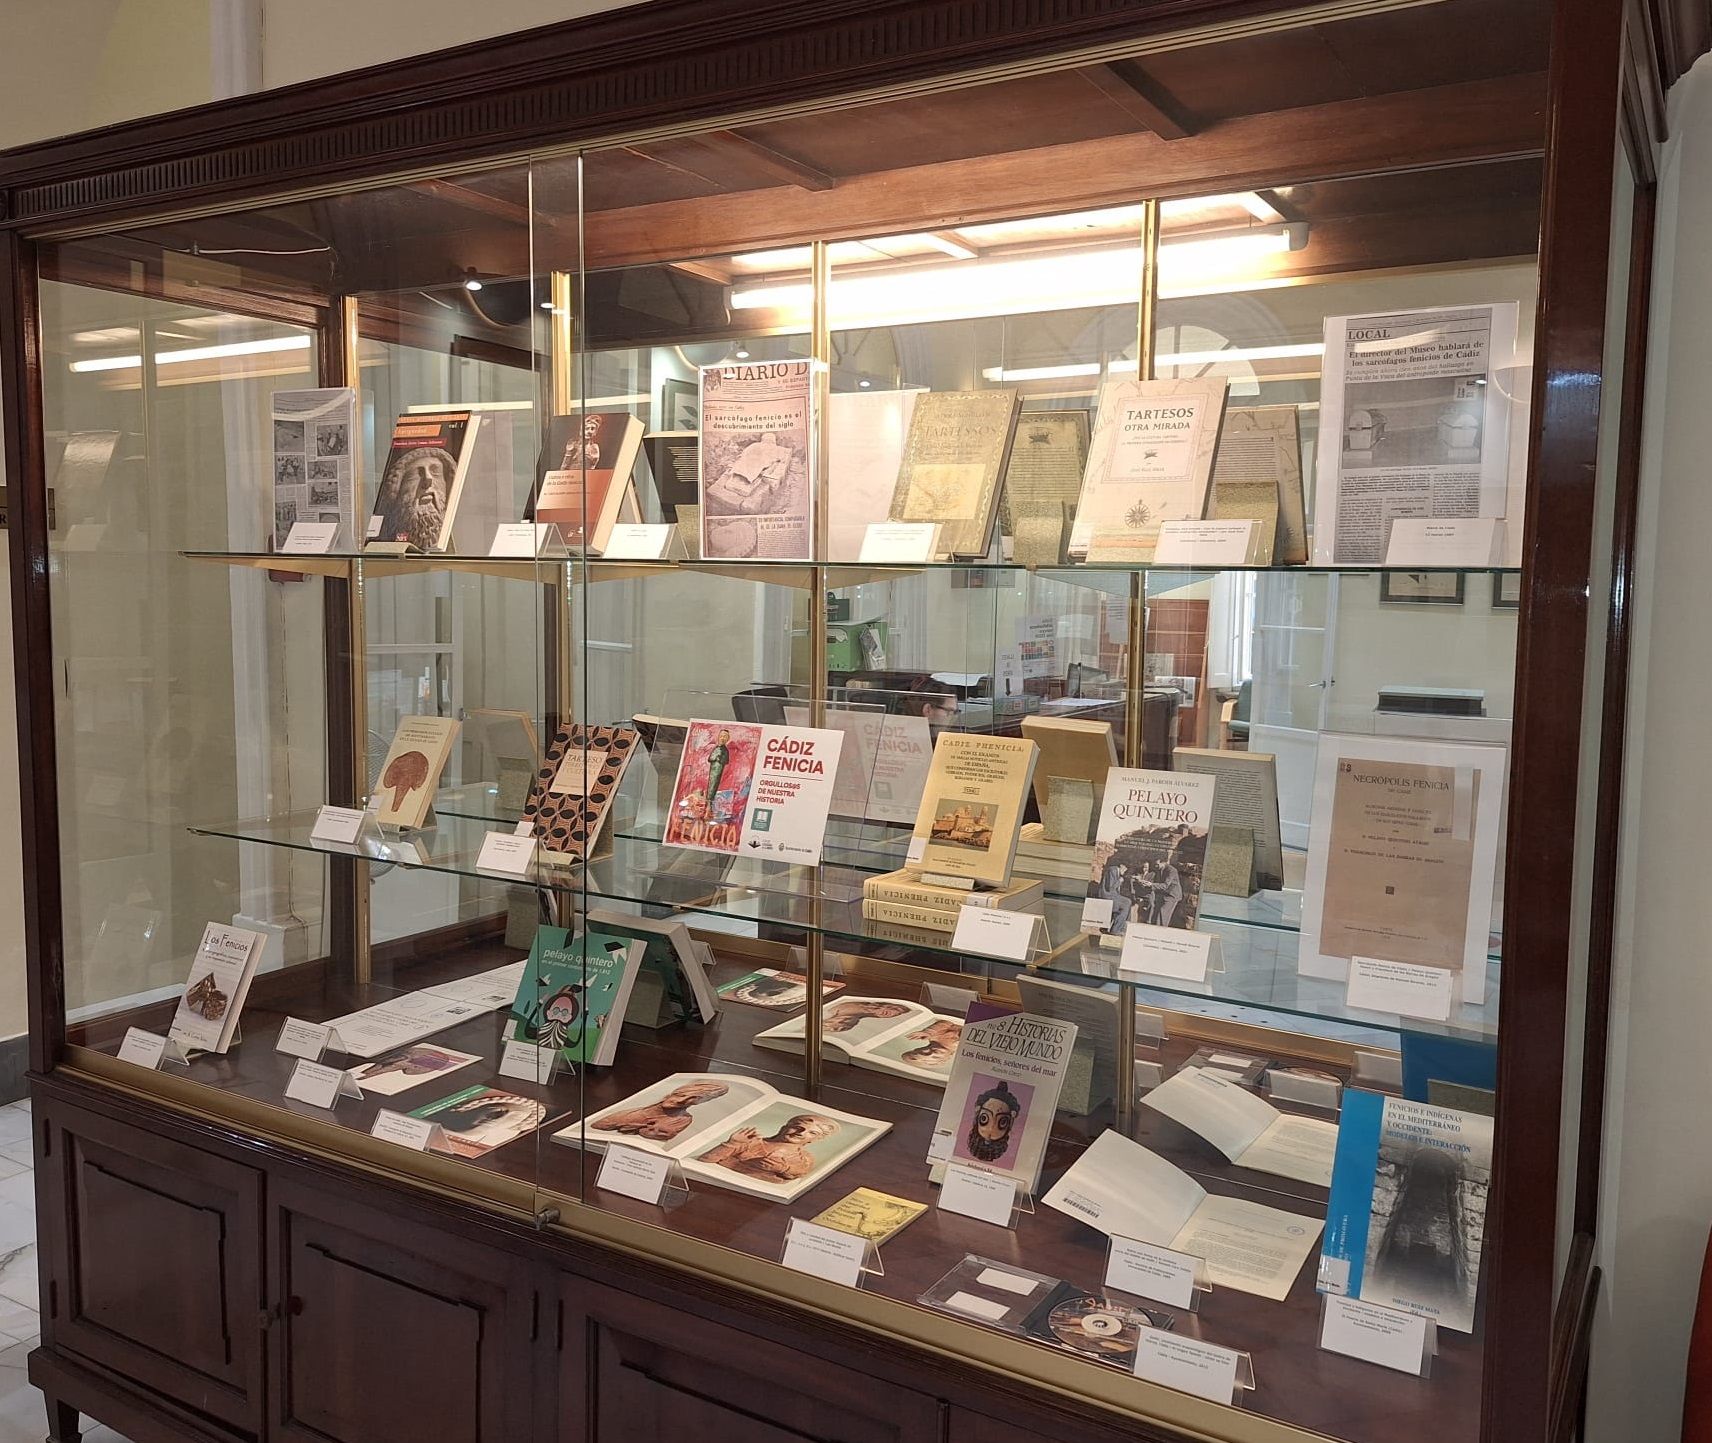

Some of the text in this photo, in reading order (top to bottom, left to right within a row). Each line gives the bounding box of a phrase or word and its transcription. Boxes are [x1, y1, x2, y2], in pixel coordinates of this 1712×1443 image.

[1348, 329, 1391, 340] LOCAL
[1394, 347, 1407, 355] del
[1410, 345, 1436, 354] Museo
[1473, 340, 1485, 348] de
[1352, 359, 1364, 367] los
[1409, 354, 1441, 363] fenicios
[1443, 352, 1454, 360] de
[755, 413, 782, 421] fenicio
[1127, 407, 1195, 420] TARTESOS
[713, 420, 794, 430] descubrimiento del siglo
[1124, 421, 1191, 432] OTRA MIRADA
[767, 736, 815, 756] CÁDIZ
[942, 740, 971, 748] CADIZ
[763, 755, 824, 775] FENICIA
[758, 787, 796, 798] DE NUESTRA
[1413, 779, 1450, 792] FENICIA
[756, 795, 785, 805] HISTORIA
[1128, 788, 1187, 806] PELAYO
[1113, 803, 1198, 823] QUINTERO
[669, 817, 737, 847] FENICIA
[884, 890, 963, 907] CADIZ PHENICIA
[883, 909, 956, 926] ADIZ PHENICIA
[204, 929, 249, 952] Los Fenicios
[543, 949, 574, 962] pelayo
[996, 1020, 1007, 1031] 8
[1007, 1016, 1067, 1043] HISTORIAS
[966, 1028, 1063, 1060] DEL VIEJO MUNDO
[961, 1049, 975, 1058] Los
[1003, 1059, 1030, 1071] señores
[1030, 1063, 1041, 1074] del
[1042, 1067, 1058, 1077] mar
[1389, 1103, 1419, 1115] FENICIOS
[1426, 1109, 1463, 1123] INDÍGENAS
[1407, 1115, 1461, 1132] MEDITERRÁNEO
[1424, 1137, 1471, 1153] INTERACCIÓN
